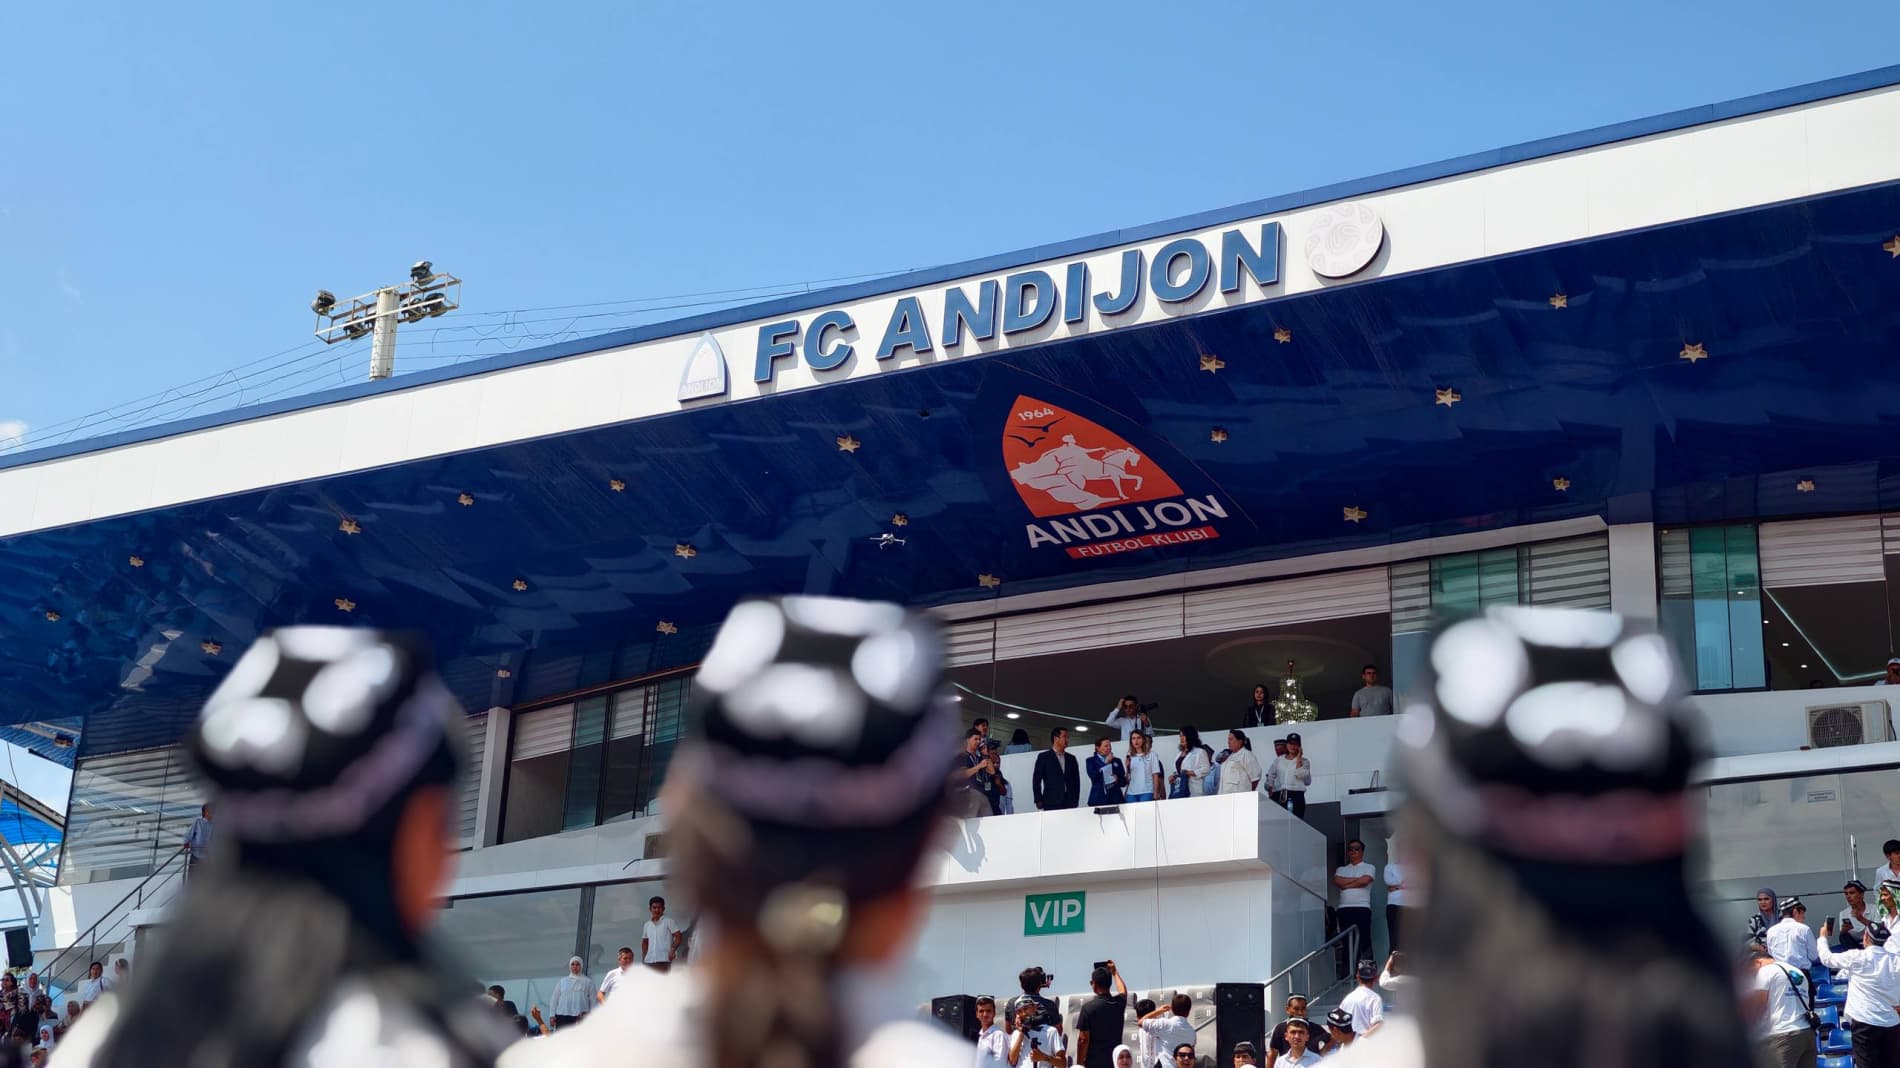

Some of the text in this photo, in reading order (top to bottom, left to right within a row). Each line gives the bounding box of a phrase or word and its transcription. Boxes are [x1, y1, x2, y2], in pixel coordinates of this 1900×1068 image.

[754, 221, 1280, 383] FC ANDIJON
[1018, 407, 1054, 421] 1964
[1026, 494, 1229, 549] ANDIJON
[1078, 528, 1209, 557] FUTBOL KLUBI
[1029, 899, 1082, 928] VIP
